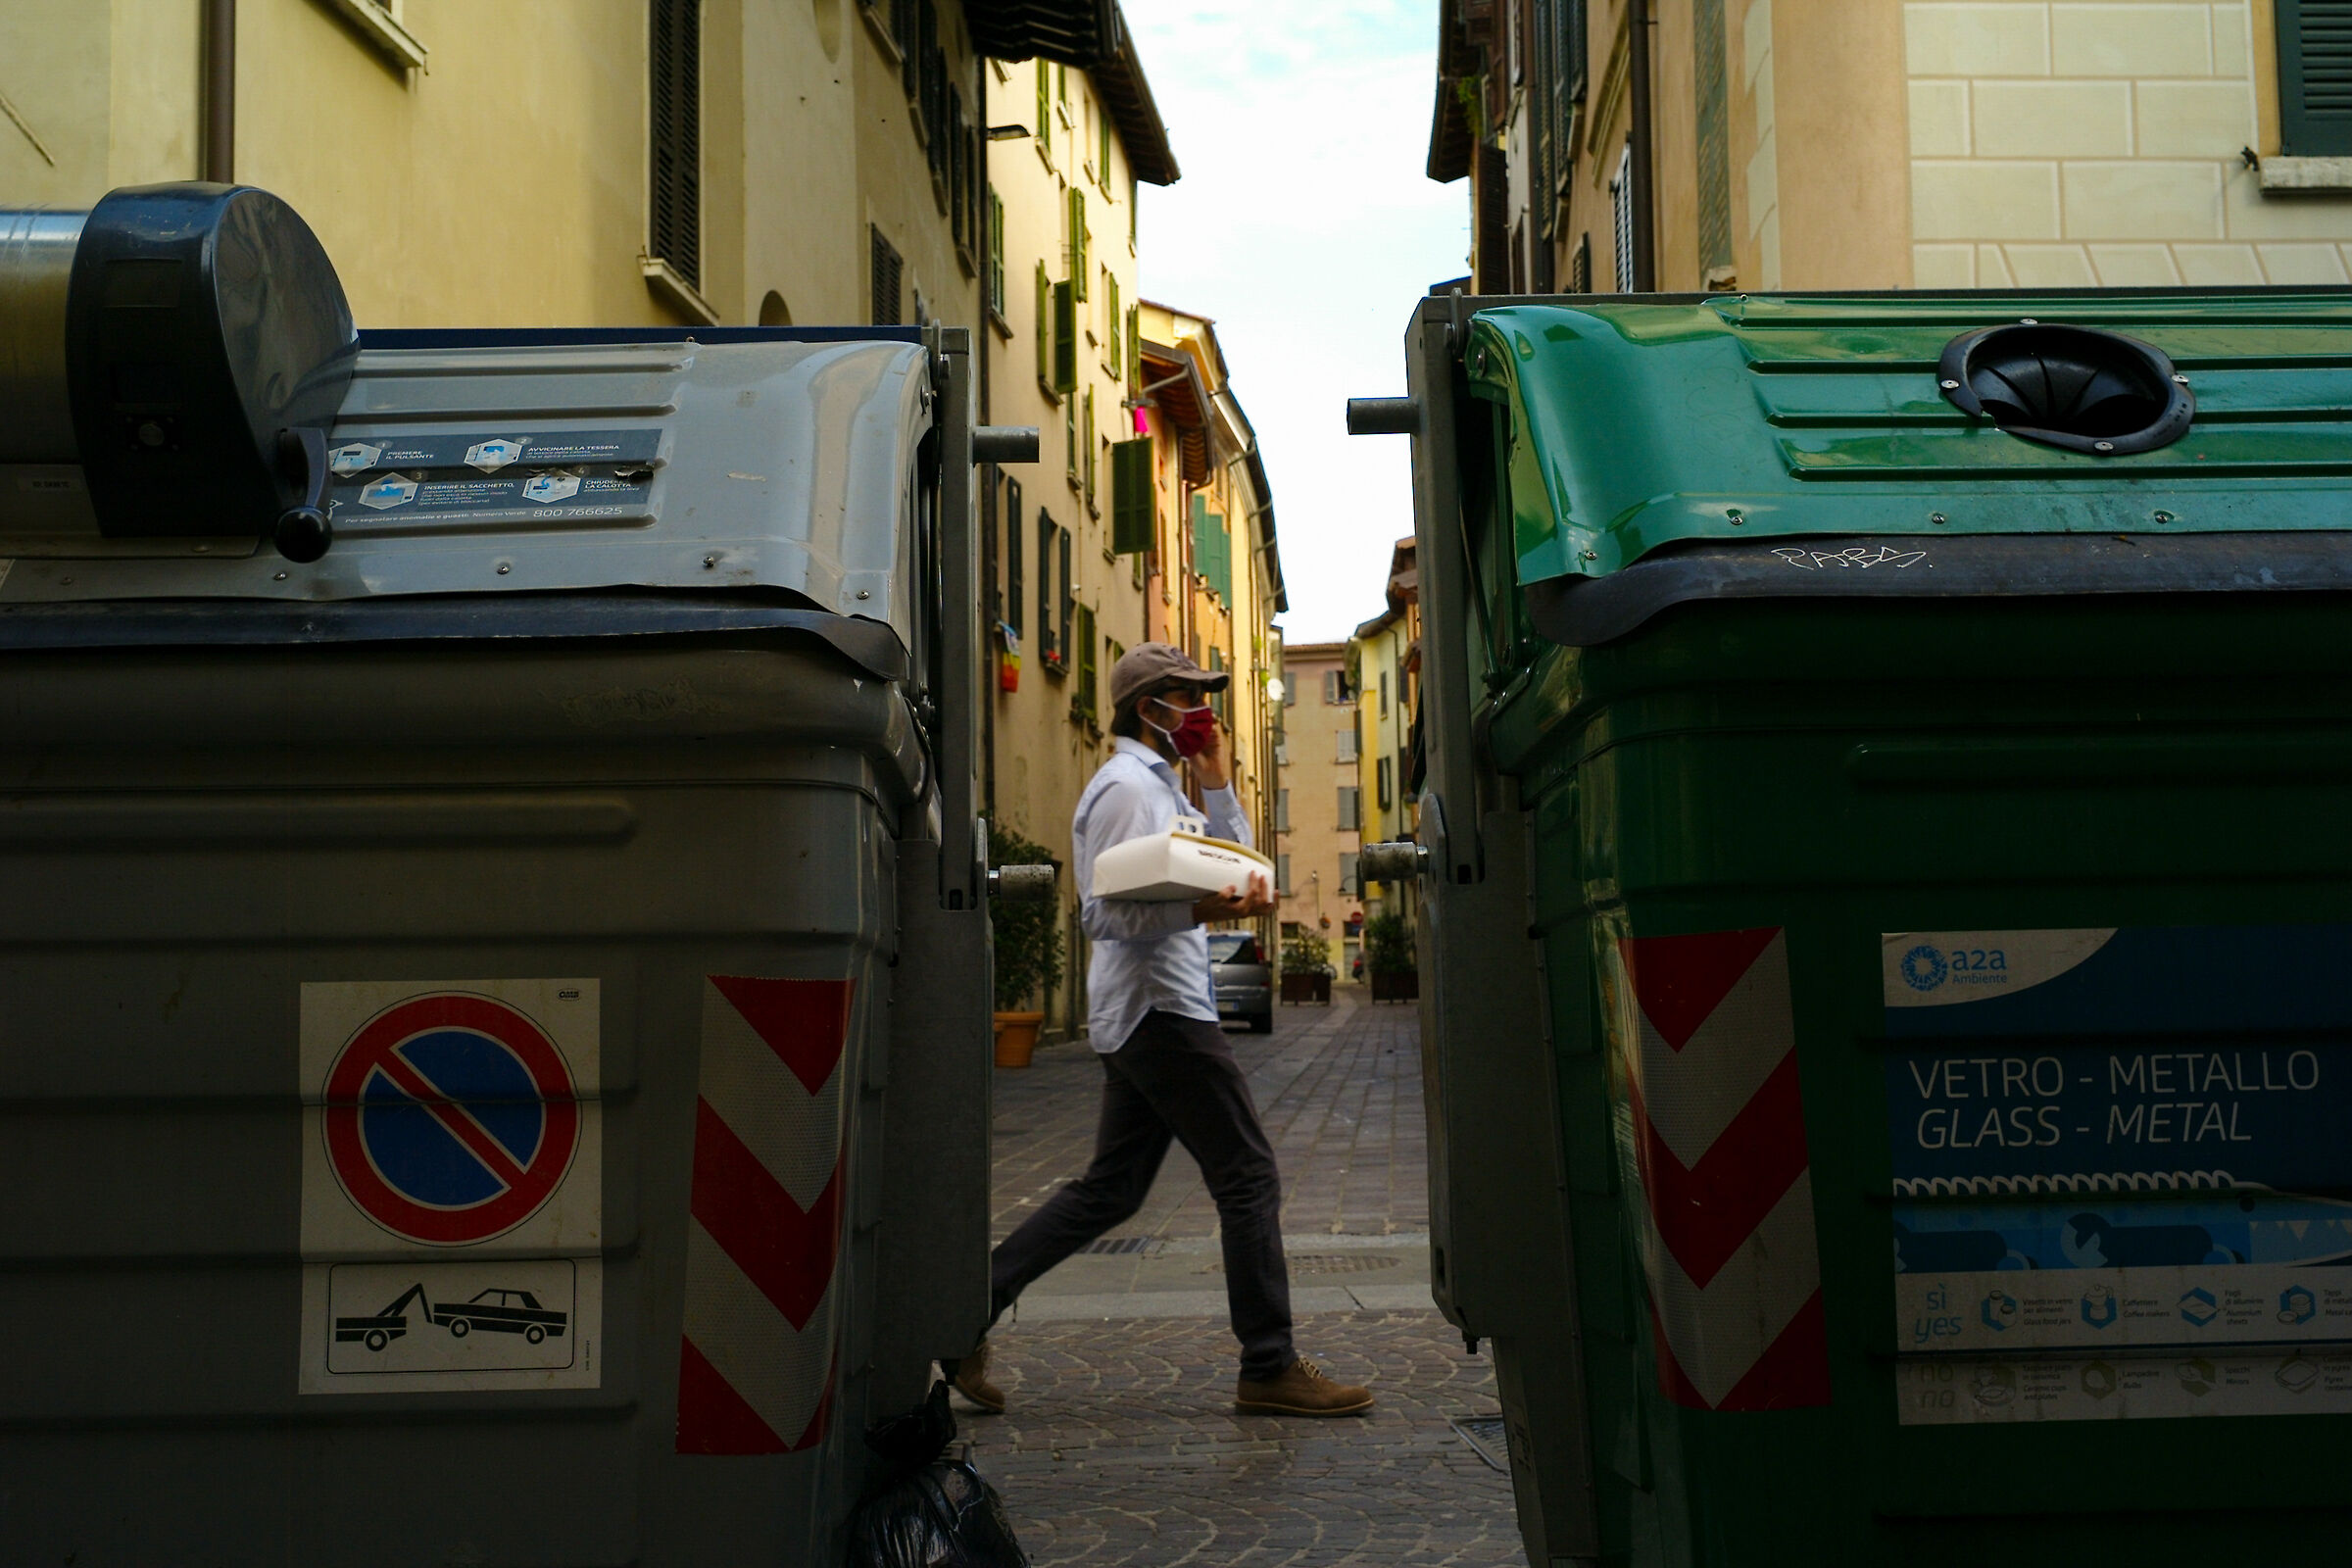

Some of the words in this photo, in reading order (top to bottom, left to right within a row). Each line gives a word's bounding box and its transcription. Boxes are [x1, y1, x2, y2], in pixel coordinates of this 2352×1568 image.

[533, 509, 563, 517] 800
[567, 507, 623, 515] 766625
[1951, 949, 2007, 971] a2a
[1952, 973, 2008, 984] Ambiente
[1908, 1055, 2064, 1100] VETRO
[2109, 1050, 2321, 1095] METALLO
[1917, 1104, 2062, 1150] GLASS
[2106, 1102, 2253, 1145] METAL
[1914, 1316, 1962, 1344] yes
[1921, 1389, 1956, 1408] no
